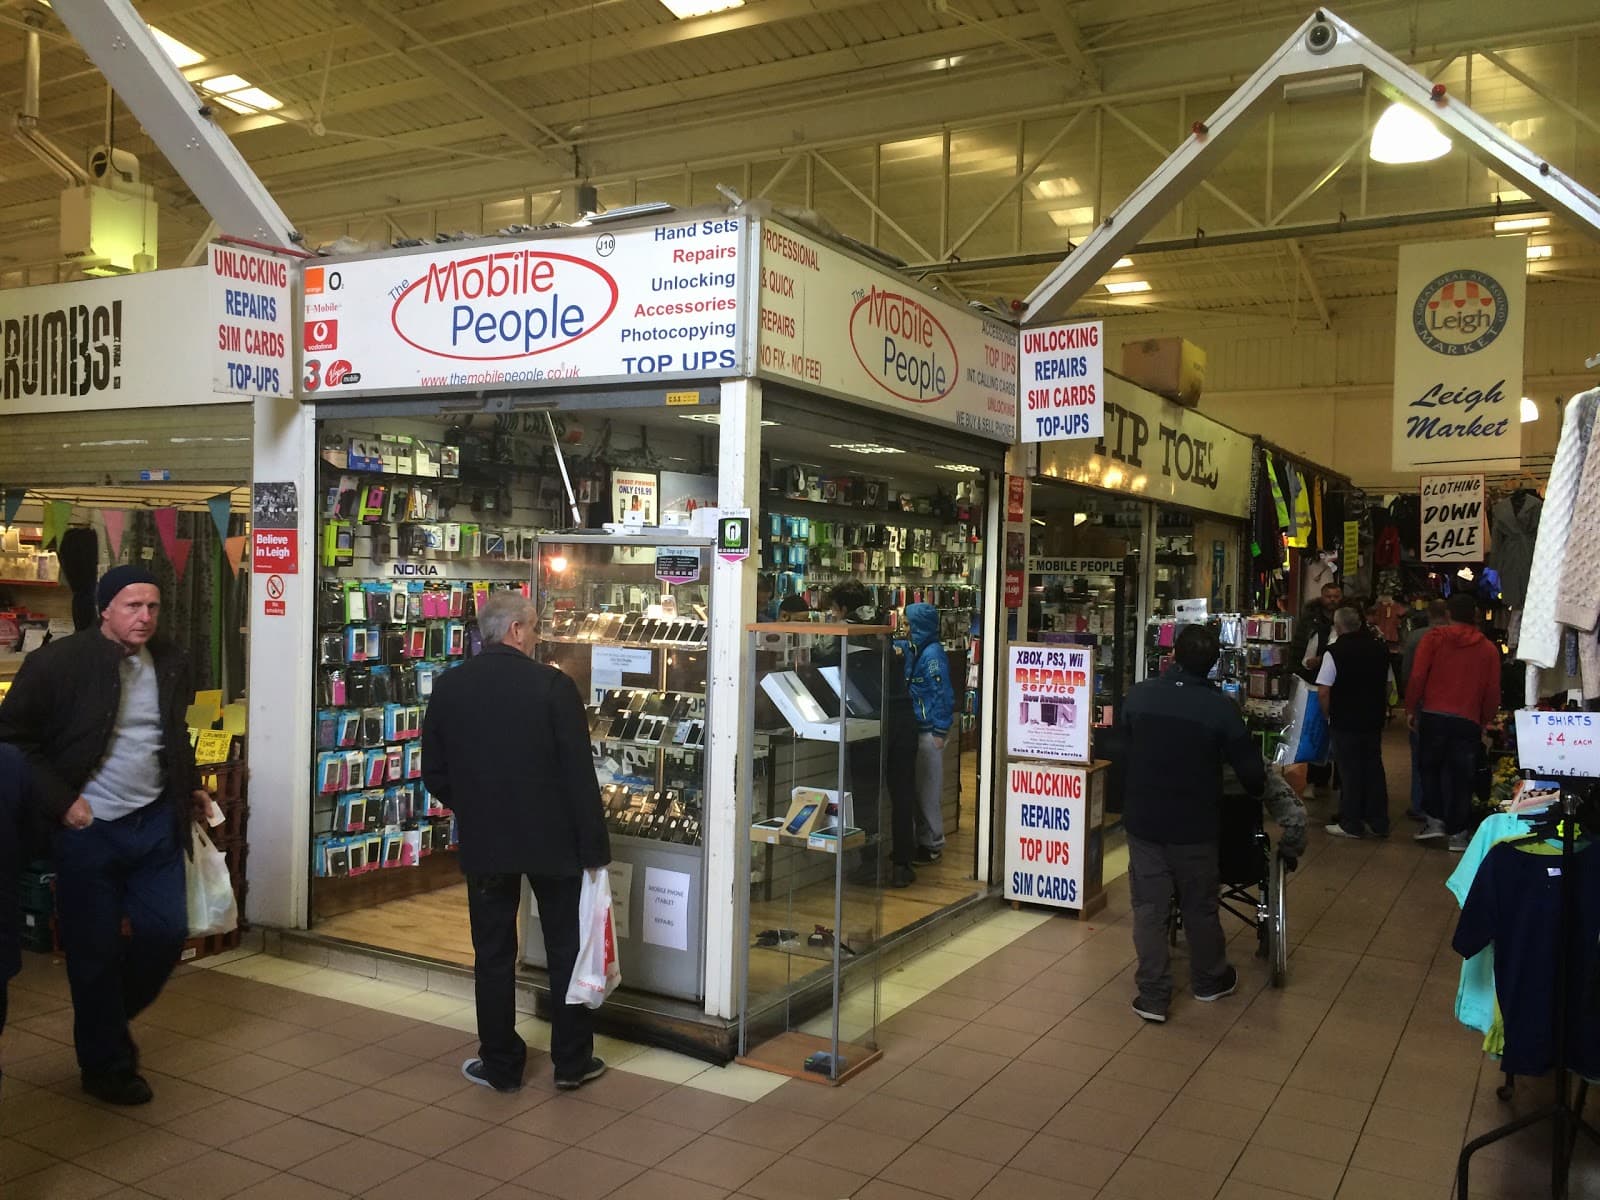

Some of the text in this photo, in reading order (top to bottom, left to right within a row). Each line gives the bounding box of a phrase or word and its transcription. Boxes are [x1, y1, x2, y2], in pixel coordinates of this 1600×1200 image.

[655, 219, 738, 241] Hand Sets
[598, 239, 614, 251] J10
[673, 245, 737, 264] Repairs
[214, 248, 287, 288] UNLOCKING
[424, 249, 555, 304] Mobile
[387, 278, 410, 301] The
[652, 272, 735, 291] Unlocking
[761, 266, 795, 299] & QUICK
[225, 289, 277, 322] REPAIRS
[634, 296, 737, 318] Accessories
[851, 288, 865, 304] The
[452, 293, 585, 353] People
[761, 308, 796, 339] REPAIRS
[868, 284, 933, 349] Mobile
[1431, 309, 1491, 334] Leigh
[218, 323, 285, 359] SIM CARDS
[621, 321, 736, 343] Photocopying
[1024, 325, 1099, 354] UNLOCKING
[1419, 326, 1499, 355] MARKET
[0, 300, 122, 400] RUMBS!
[622, 349, 736, 375] TOP UPS
[985, 343, 1016, 375] TOP UPS
[227, 361, 280, 393] TOP-UPS
[304, 359, 321, 391] 3
[421, 365, 581, 387] www.themobilepeople.co.uk
[773, 347, 785, 369] FIX
[791, 353, 803, 375] NO
[805, 357, 822, 384] FEE)
[884, 336, 946, 400] People
[1035, 356, 1087, 381] REPAIRS
[977, 370, 999, 391] CALLING
[1000, 378, 1015, 396] CARDS
[987, 396, 1015, 417] UNLOCKING
[1028, 384, 1096, 410] SIM CARDS
[1409, 379, 1506, 413] Leigh
[956, 409, 965, 426] WE
[982, 416, 994, 433] SELL
[1036, 413, 1089, 437] TOP-UPS
[1407, 414, 1508, 439] Market
[619, 485, 633, 494] ONLY
[1423, 477, 1481, 496] CLOTHING
[1423, 501, 1481, 525] DOWN
[256, 533, 288, 545] Believe
[1425, 526, 1477, 553] SALE
[256, 546, 290, 560] in Leigh
[393, 564, 438, 576] NOKIA
[1036, 560, 1077, 572] MOBILE
[1080, 561, 1124, 572] PEOPLE
[1016, 651, 1084, 669] XBOX, PS3, Wii
[1015, 667, 1086, 688] REPAIR
[1022, 683, 1075, 694] service
[1040, 694, 1075, 705] Available
[1532, 714, 1592, 726] T SHIRTS
[1547, 732, 1566, 746] £4
[1012, 769, 1081, 799] UNLOCKING
[1021, 803, 1070, 831] REPAIRS
[1020, 837, 1069, 865] TOP UPS
[648, 884, 684, 898] MOBILE PHONE
[1012, 870, 1077, 902] SIM CARDS
[655, 896, 674, 906] /TABLET
[654, 917, 674, 927] REPAIRS
